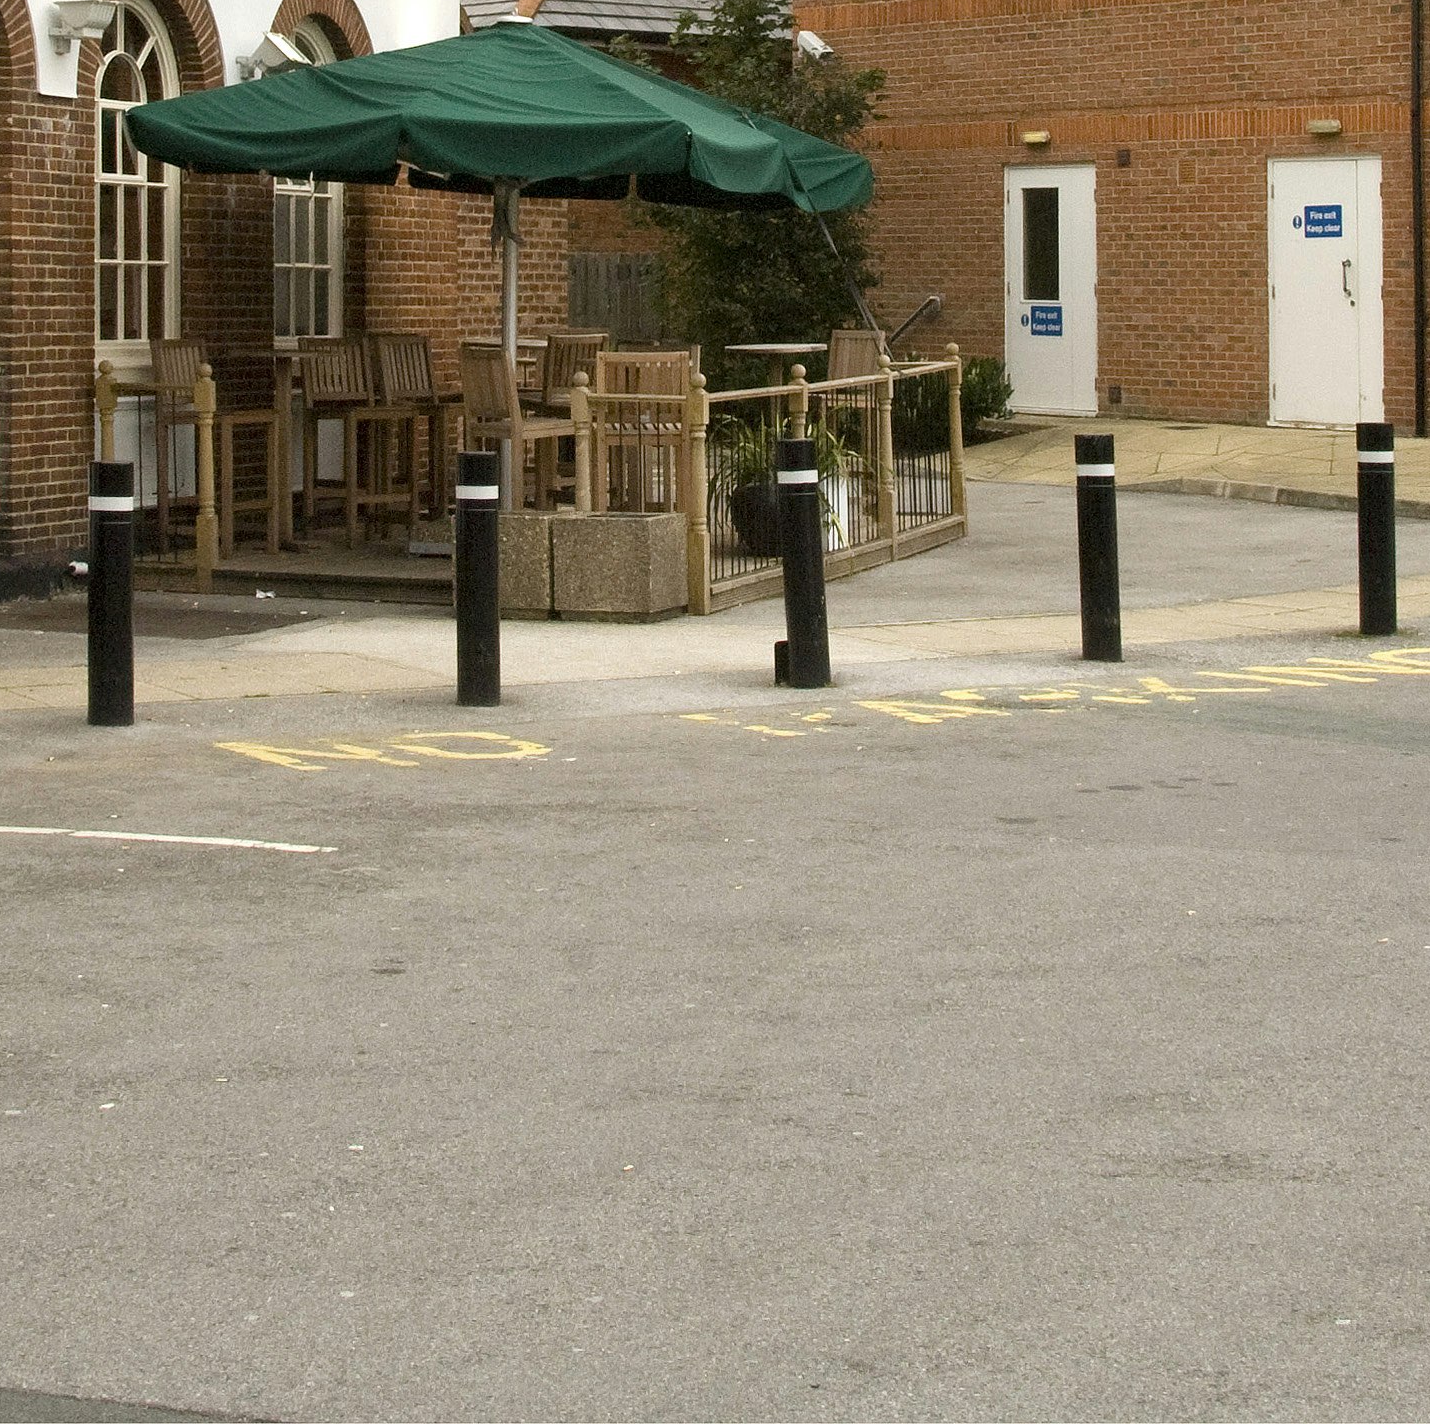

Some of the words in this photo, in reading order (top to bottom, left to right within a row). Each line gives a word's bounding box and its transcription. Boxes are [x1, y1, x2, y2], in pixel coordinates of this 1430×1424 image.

[1310, 211, 1323, 220] Fire
[1324, 211, 1336, 220] exit
[1307, 225, 1323, 234] Keep
[1324, 224, 1340, 232] clear
[1033, 323, 1046, 332] Keep
[1048, 323, 1061, 331] clear
[213, 730, 554, 772] NO
